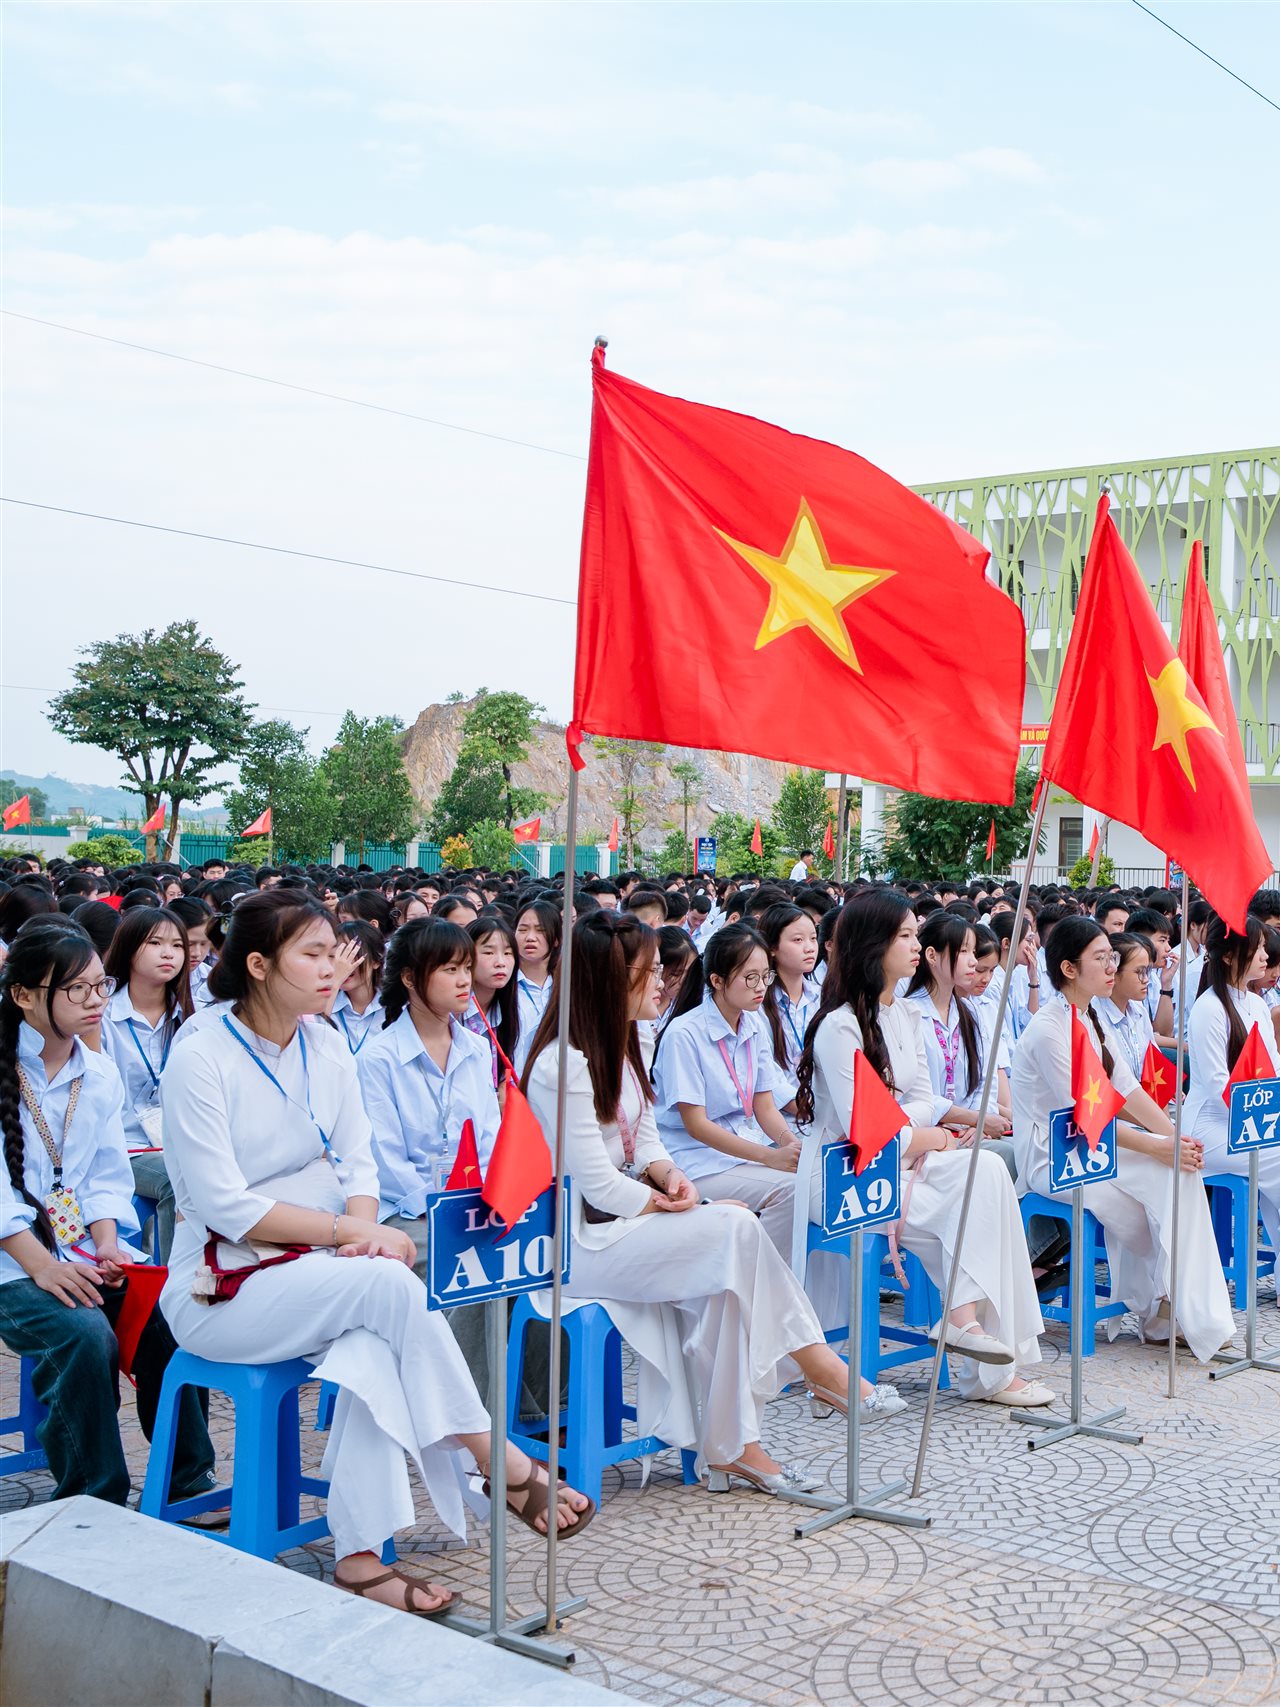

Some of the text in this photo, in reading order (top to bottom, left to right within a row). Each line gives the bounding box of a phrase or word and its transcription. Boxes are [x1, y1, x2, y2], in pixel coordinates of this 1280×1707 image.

[1243, 1087, 1274, 1108] LỚP
[1235, 1111, 1280, 1145] A7
[1058, 1142, 1110, 1181] A8
[832, 1178, 893, 1226] A9
[442, 1235, 555, 1294] A10
